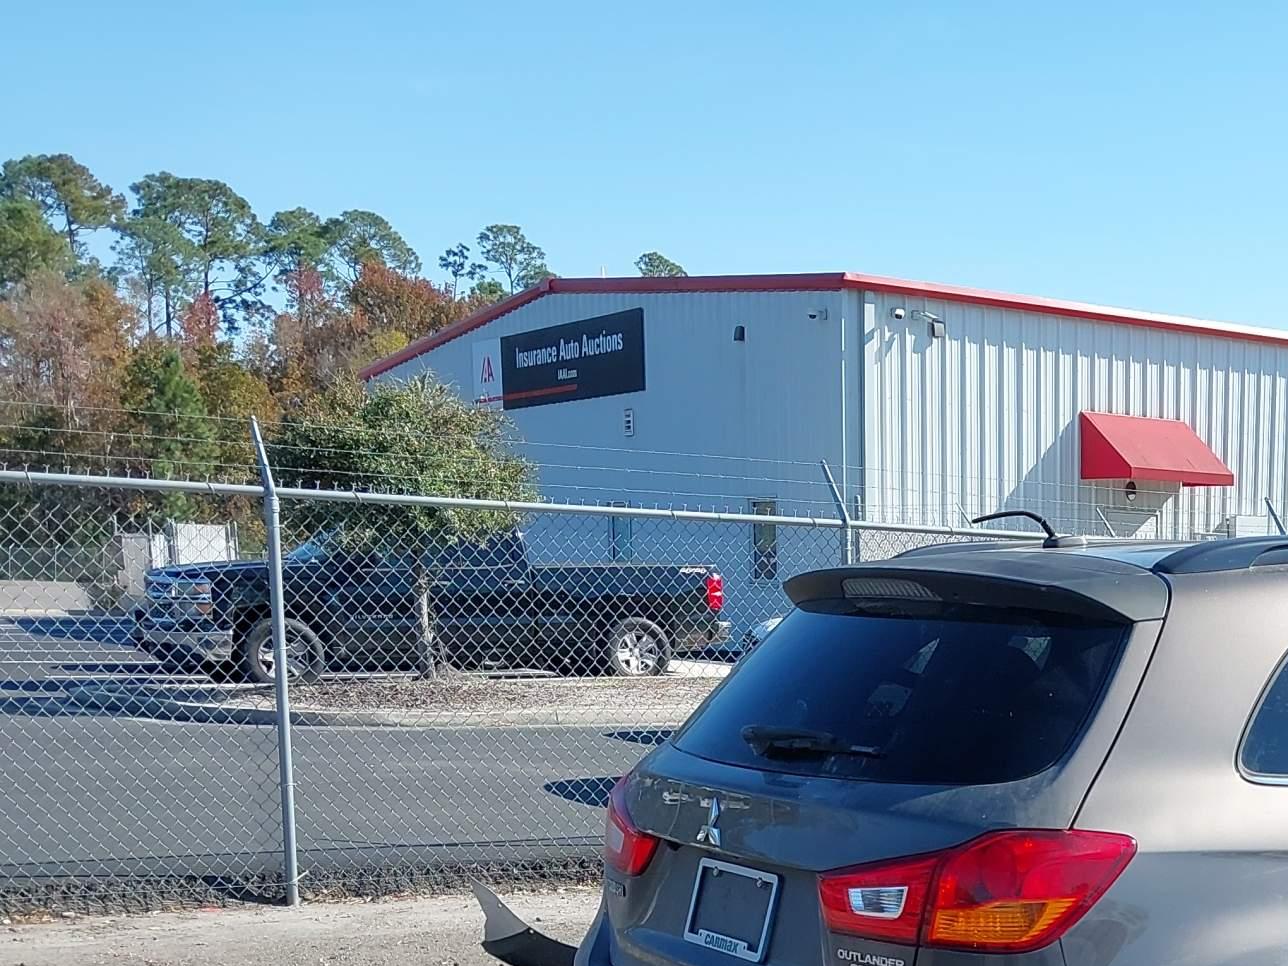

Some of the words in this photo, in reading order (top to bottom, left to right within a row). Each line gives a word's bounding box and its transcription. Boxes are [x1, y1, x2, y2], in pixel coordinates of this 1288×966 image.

[515, 345, 557, 369] Insurance
[559, 338, 580, 362] Auto
[581, 330, 623, 358] Auctions
